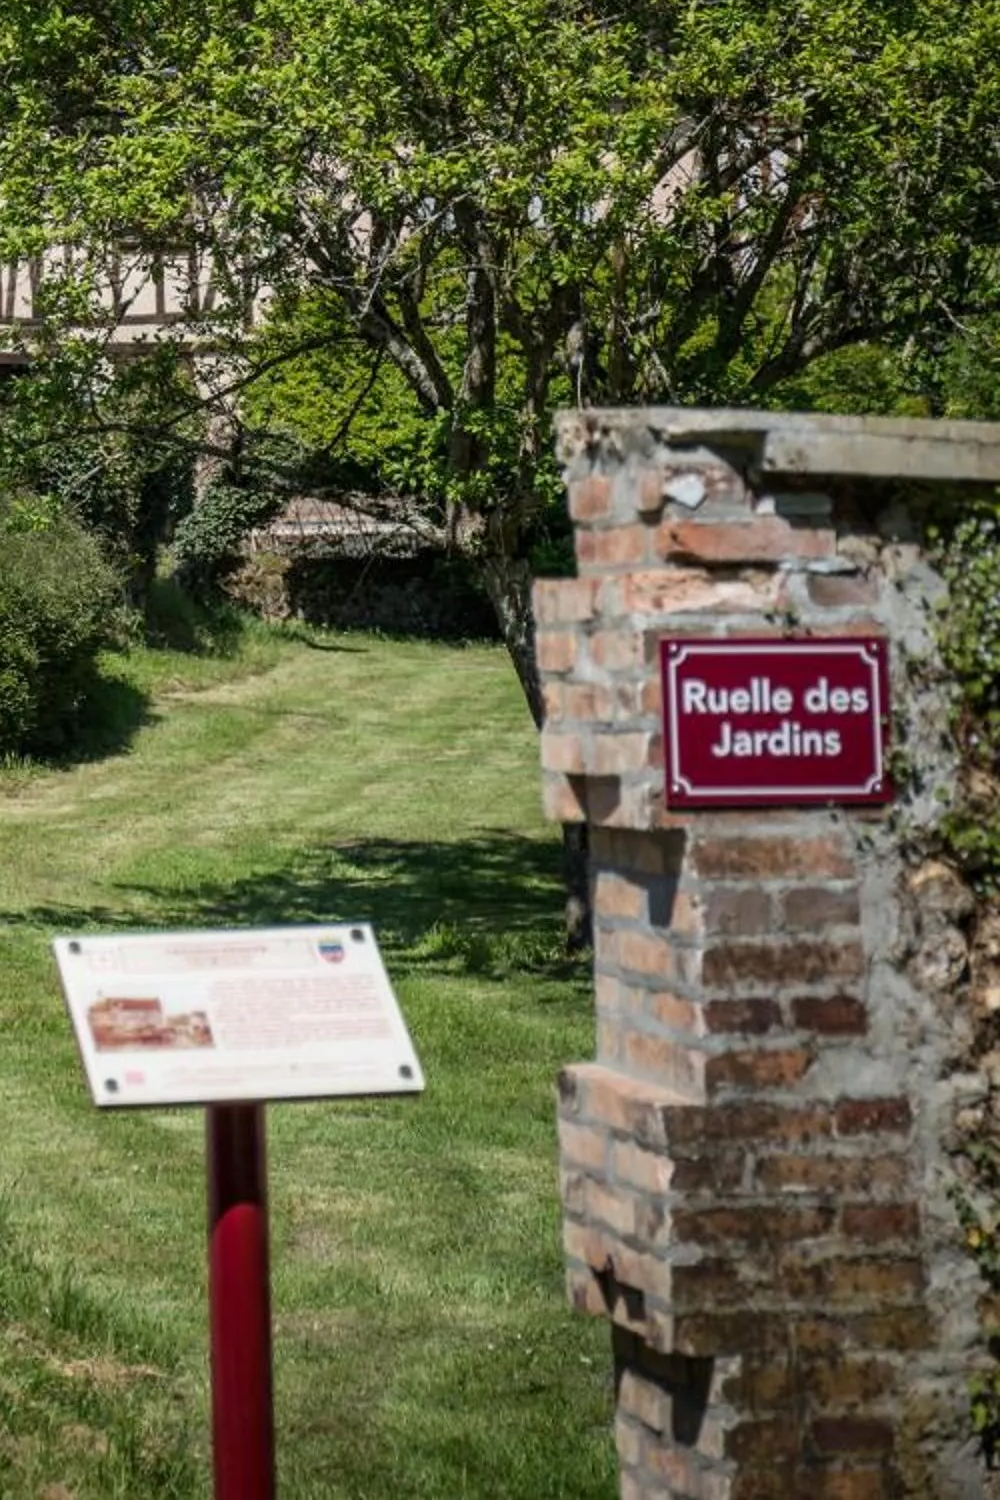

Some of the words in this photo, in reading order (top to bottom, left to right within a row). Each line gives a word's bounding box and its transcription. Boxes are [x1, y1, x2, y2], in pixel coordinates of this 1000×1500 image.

[682, 677, 793, 713] Ruelle
[804, 677, 869, 713] des
[711, 720, 842, 756] Jardins
